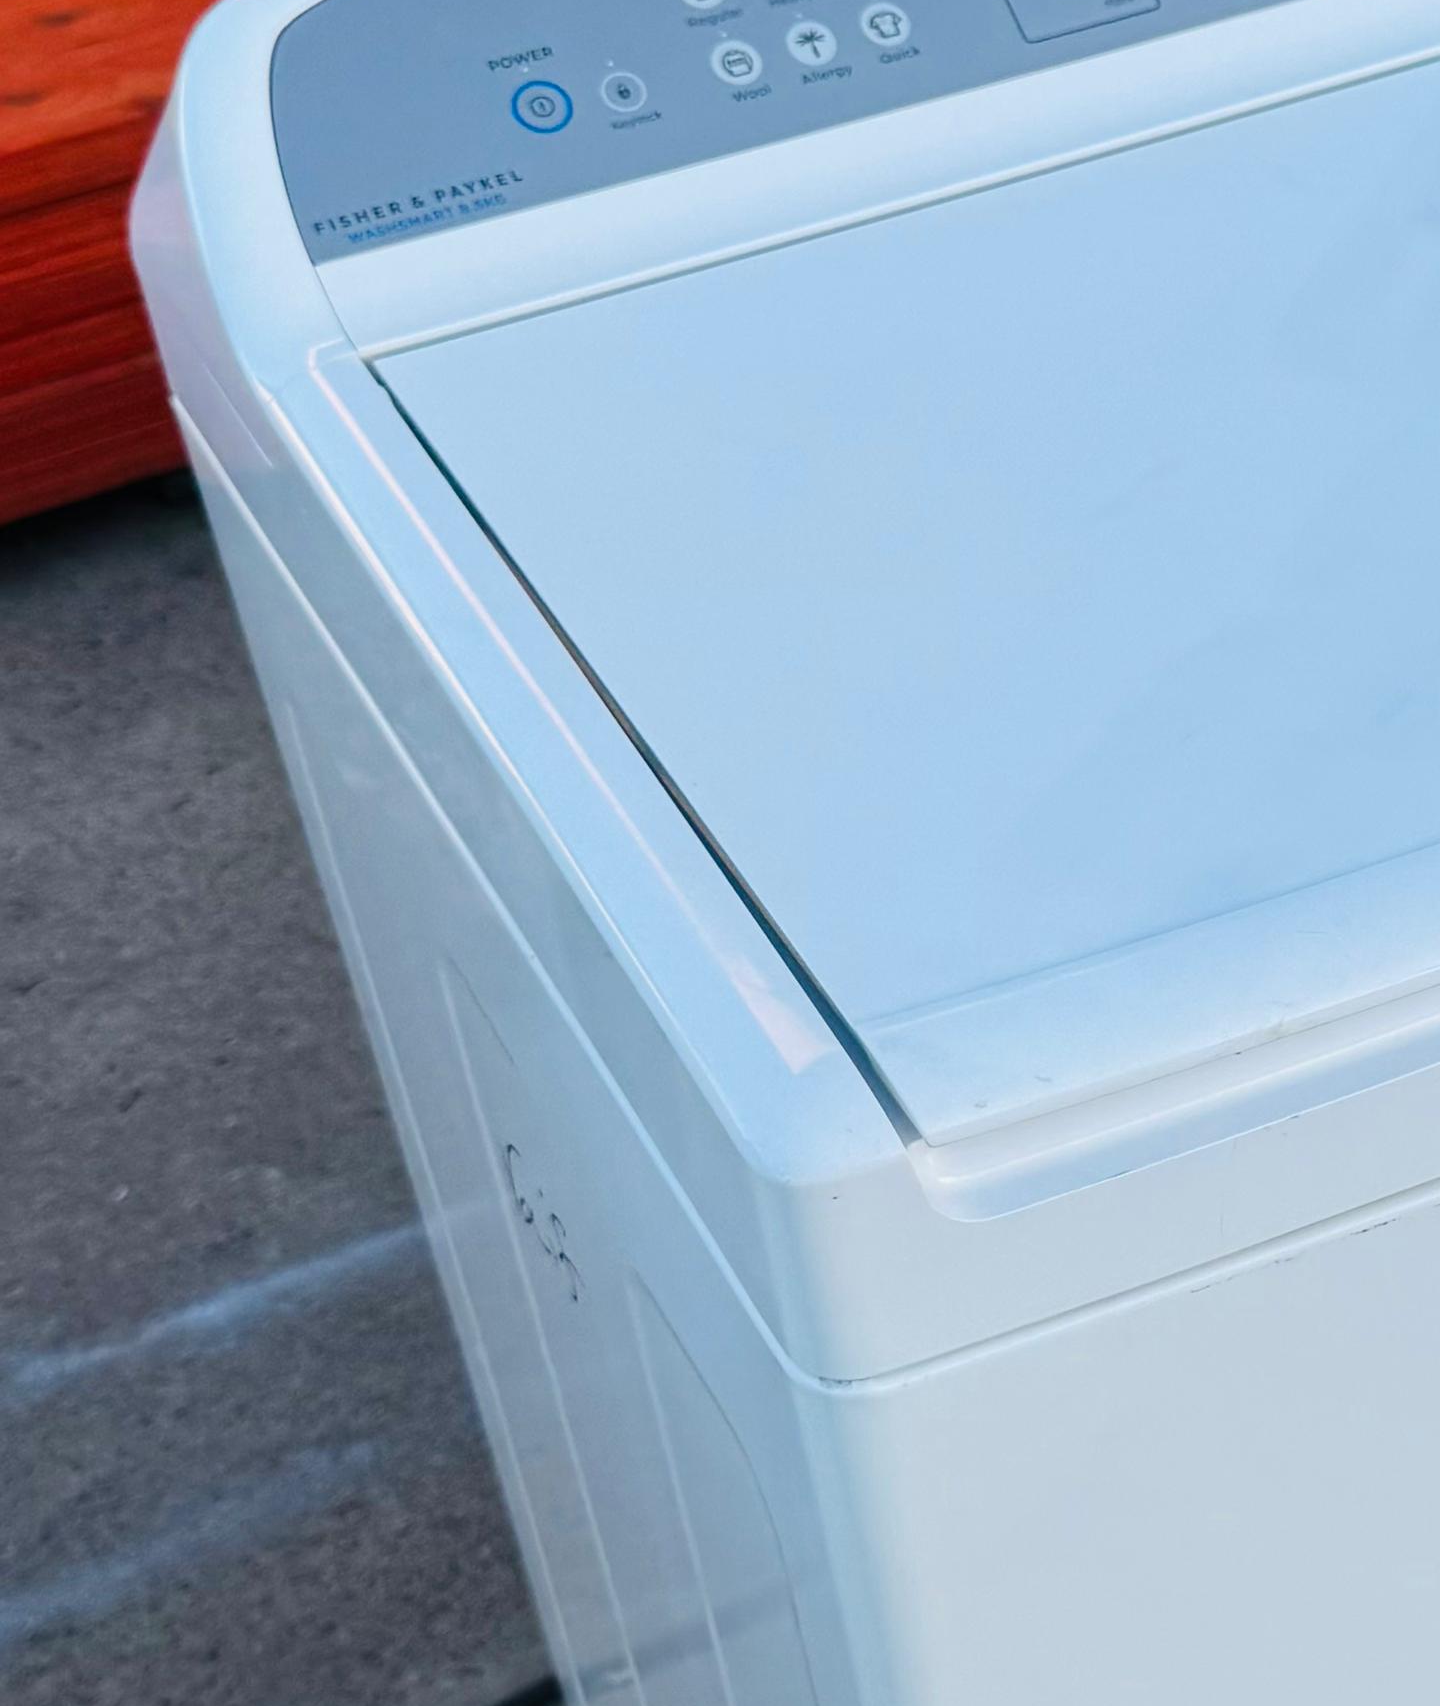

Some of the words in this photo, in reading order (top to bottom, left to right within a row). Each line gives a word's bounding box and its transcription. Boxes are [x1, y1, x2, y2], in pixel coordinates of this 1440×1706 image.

[487, 46, 554, 72] POWER
[313, 200, 402, 236] FISHER
[411, 195, 425, 210] &
[434, 169, 524, 203] PAYKEL
